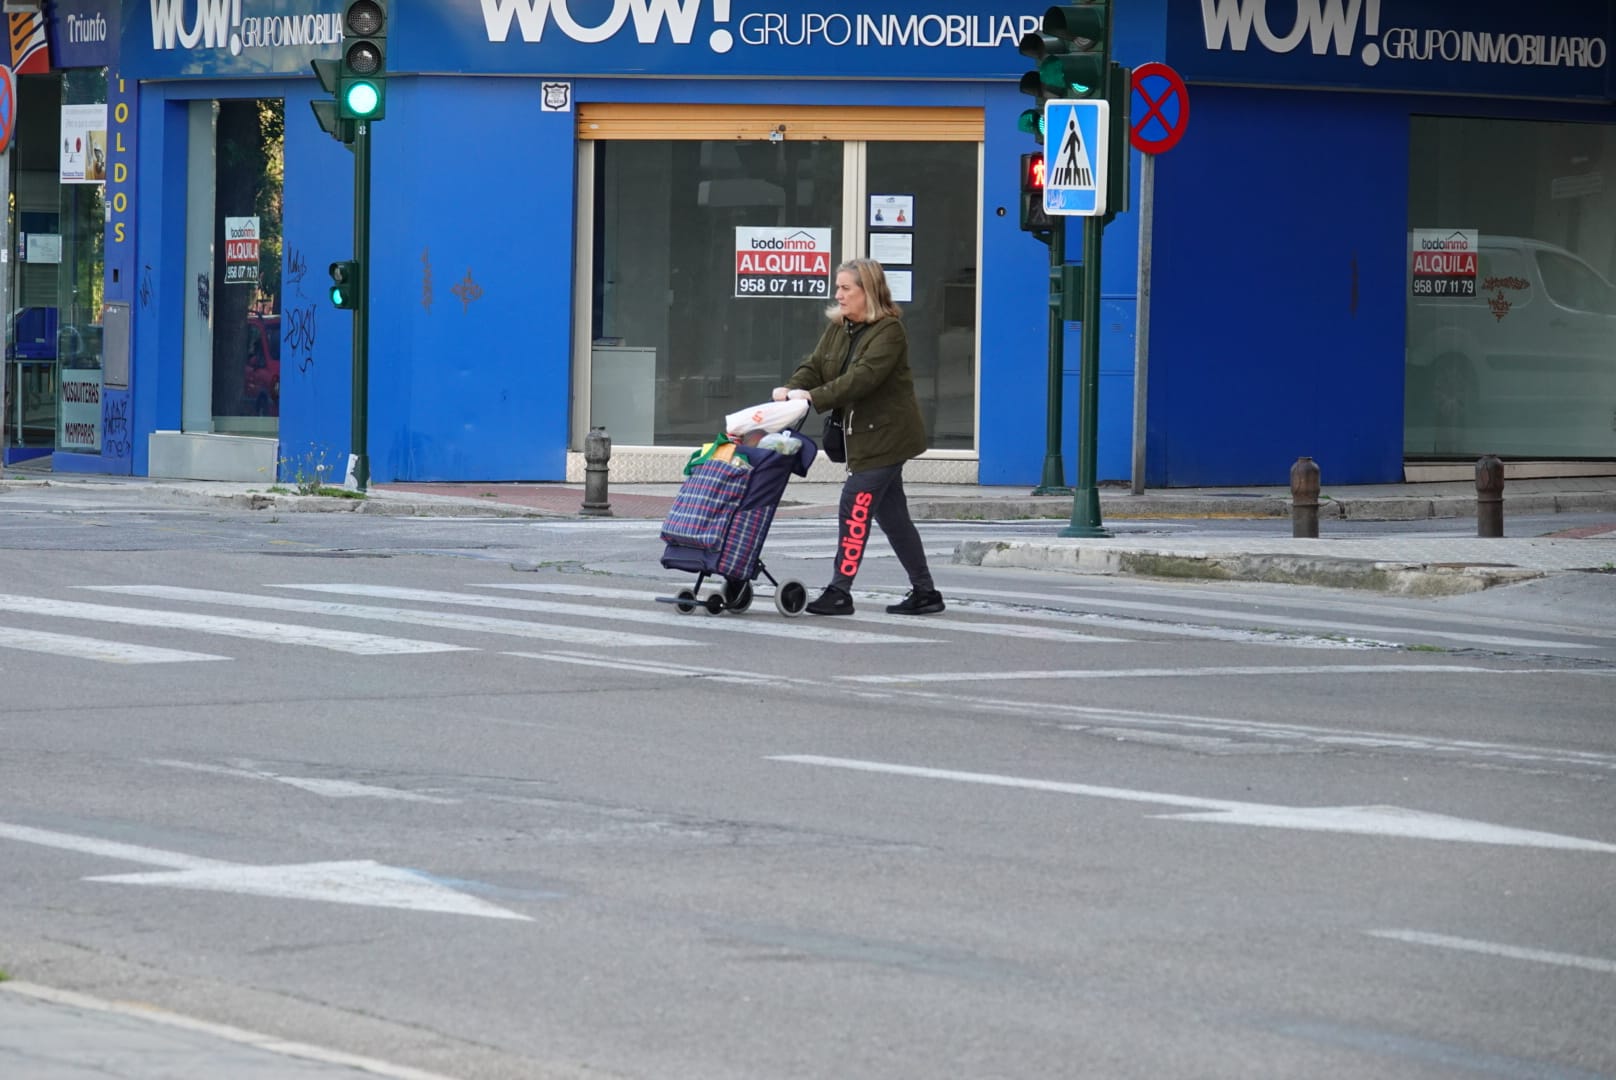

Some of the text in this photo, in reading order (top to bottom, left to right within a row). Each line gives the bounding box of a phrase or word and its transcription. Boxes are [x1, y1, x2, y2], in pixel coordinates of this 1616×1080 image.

[67, 12, 107, 43] Triunfo
[150, 0, 345, 57] WOW! GRUPO INMOBILIA
[480, 0, 734, 53] WOW!
[739, 13, 851, 46] GRUPO
[1201, 0, 1607, 68] WOW! GRUPO INMOBILIARIO
[228, 242, 258, 259] ALQUILA
[751, 238, 816, 250] todoinmo
[1422, 237, 1468, 250] todoinmo
[739, 254, 827, 273] ALQUILA
[1414, 255, 1475, 273] ALQUILA
[740, 279, 826, 294] 958 07 11 79
[1414, 279, 1474, 294] 958 07 11 79
[62, 382, 99, 404] MOSQUITERAS
[65, 423, 95, 445] MAMPARAS
[840, 491, 873, 577] adidas
